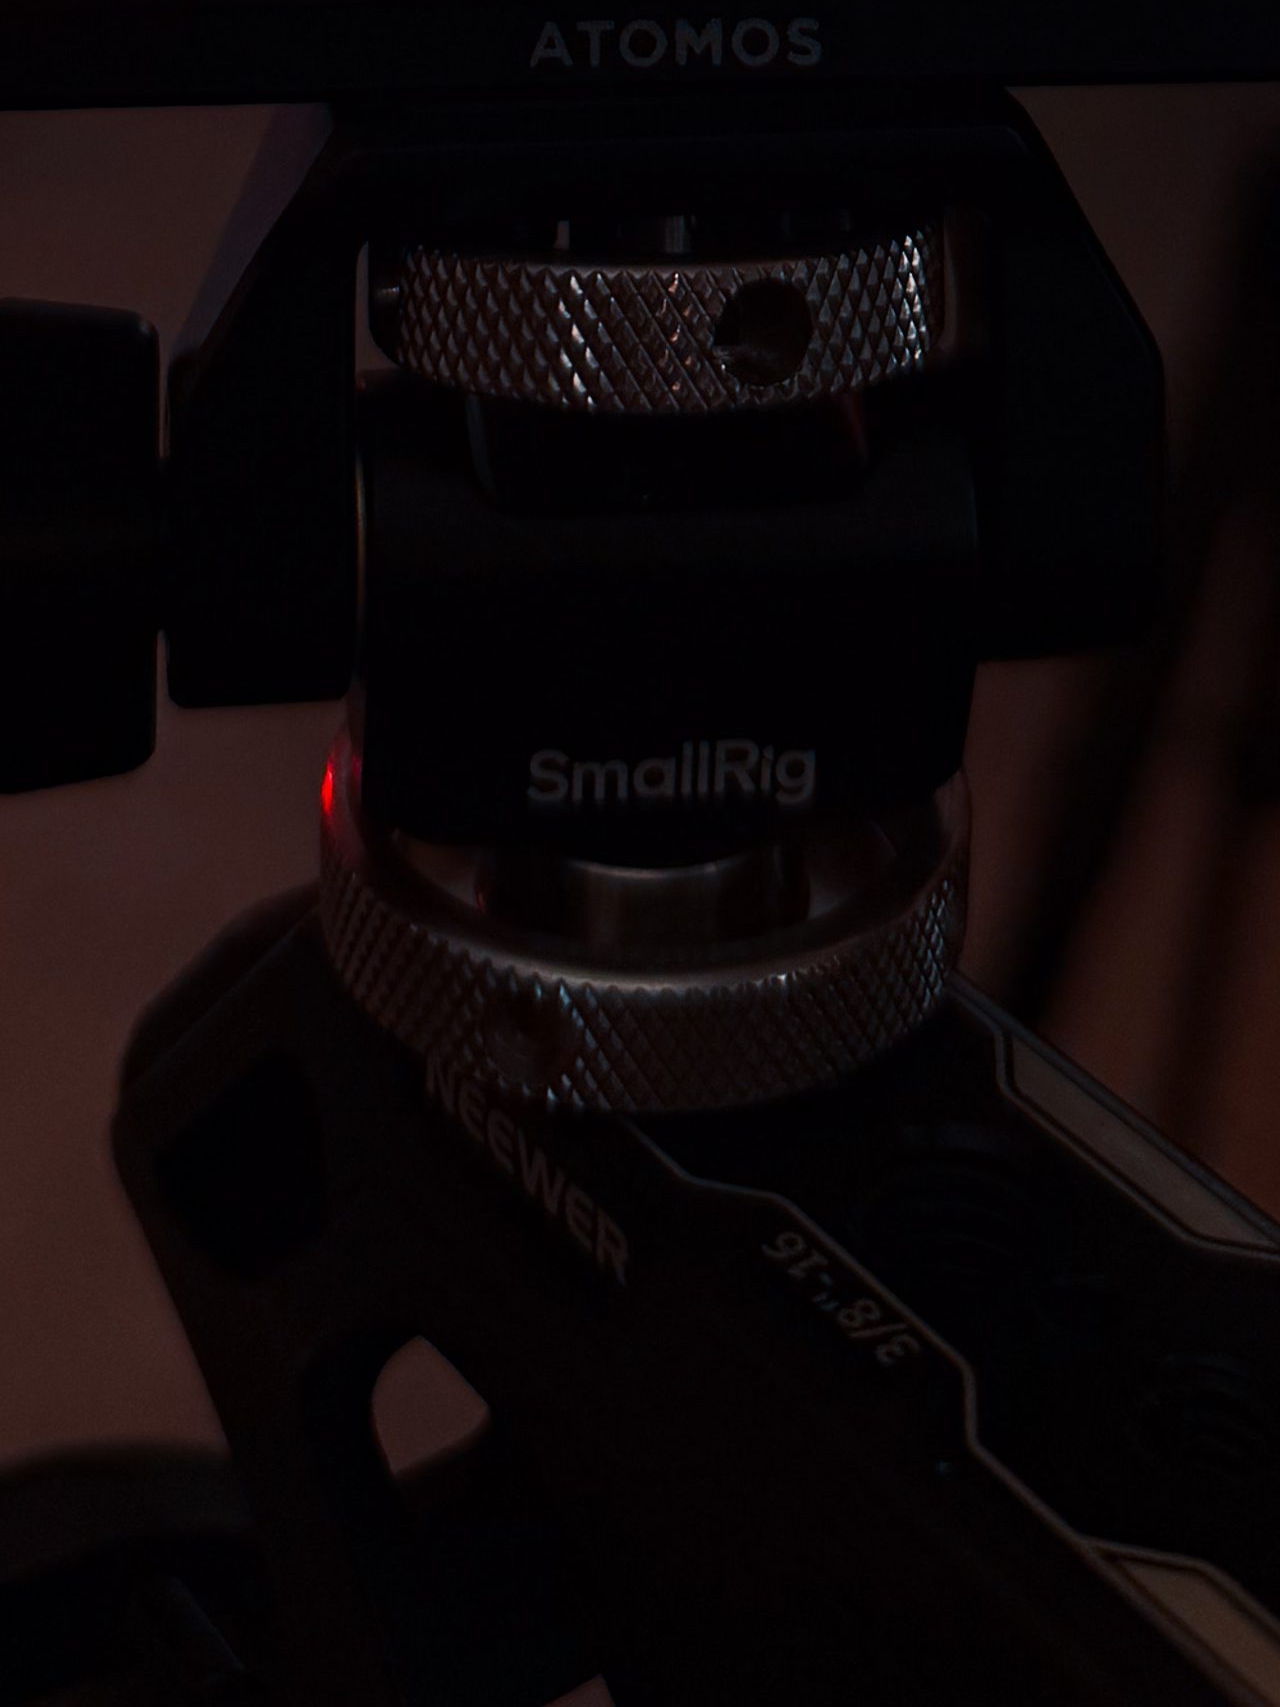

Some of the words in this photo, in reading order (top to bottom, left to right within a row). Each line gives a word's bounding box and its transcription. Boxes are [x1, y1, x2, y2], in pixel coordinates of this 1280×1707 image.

[528, 17, 823, 68] ATOMOS
[526, 738, 818, 806] SmallRig
[425, 1048, 629, 1286] NEEWER
